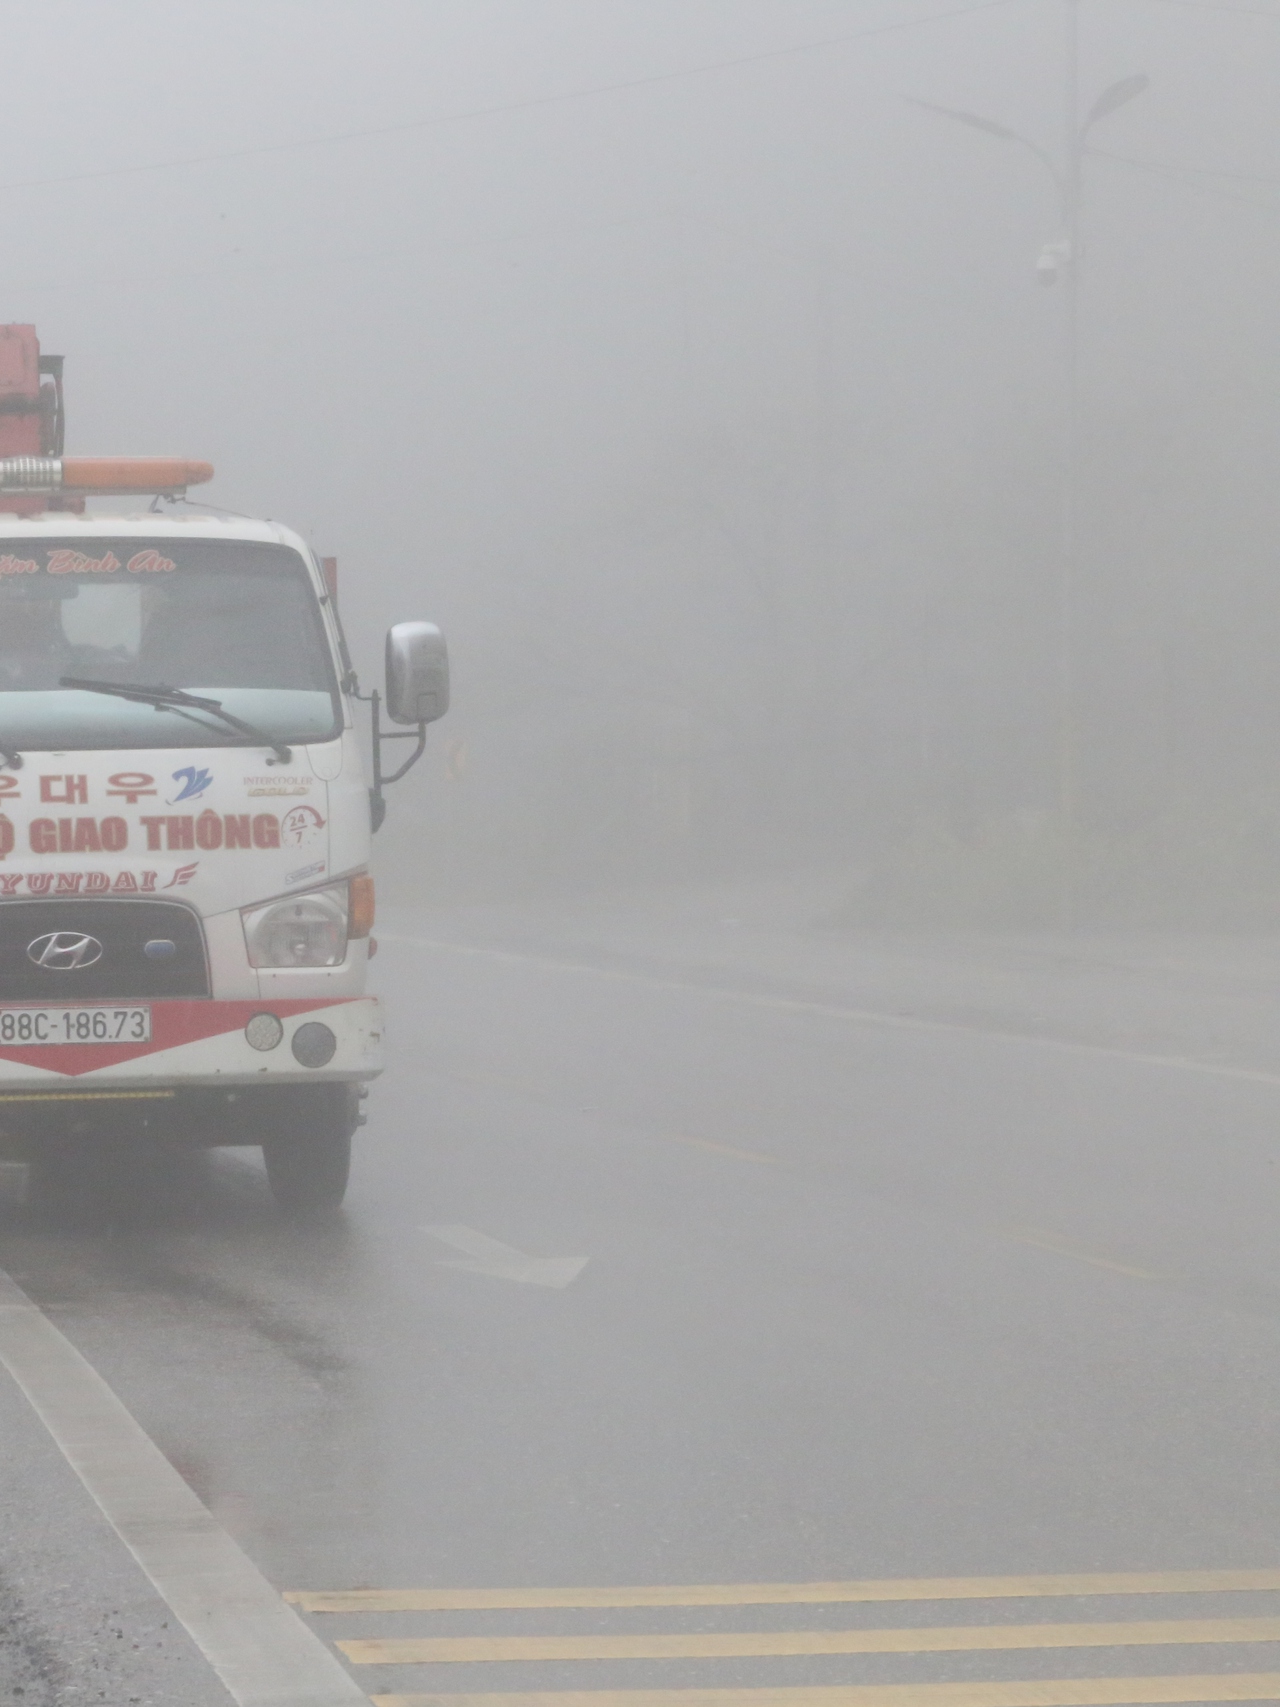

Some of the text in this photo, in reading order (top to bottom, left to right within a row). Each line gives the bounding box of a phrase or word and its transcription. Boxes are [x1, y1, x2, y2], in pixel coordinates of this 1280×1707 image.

[47, 549, 121, 575] Bình
[127, 549, 176, 573] An
[243, 776, 313, 786] INTERCOOLER
[290, 813, 305, 827] 24
[29, 816, 128, 854] GIAO
[139, 808, 281, 850] THÔNG
[296, 831, 303, 844] 7
[1, 1010, 145, 1041] 88C-186.73
